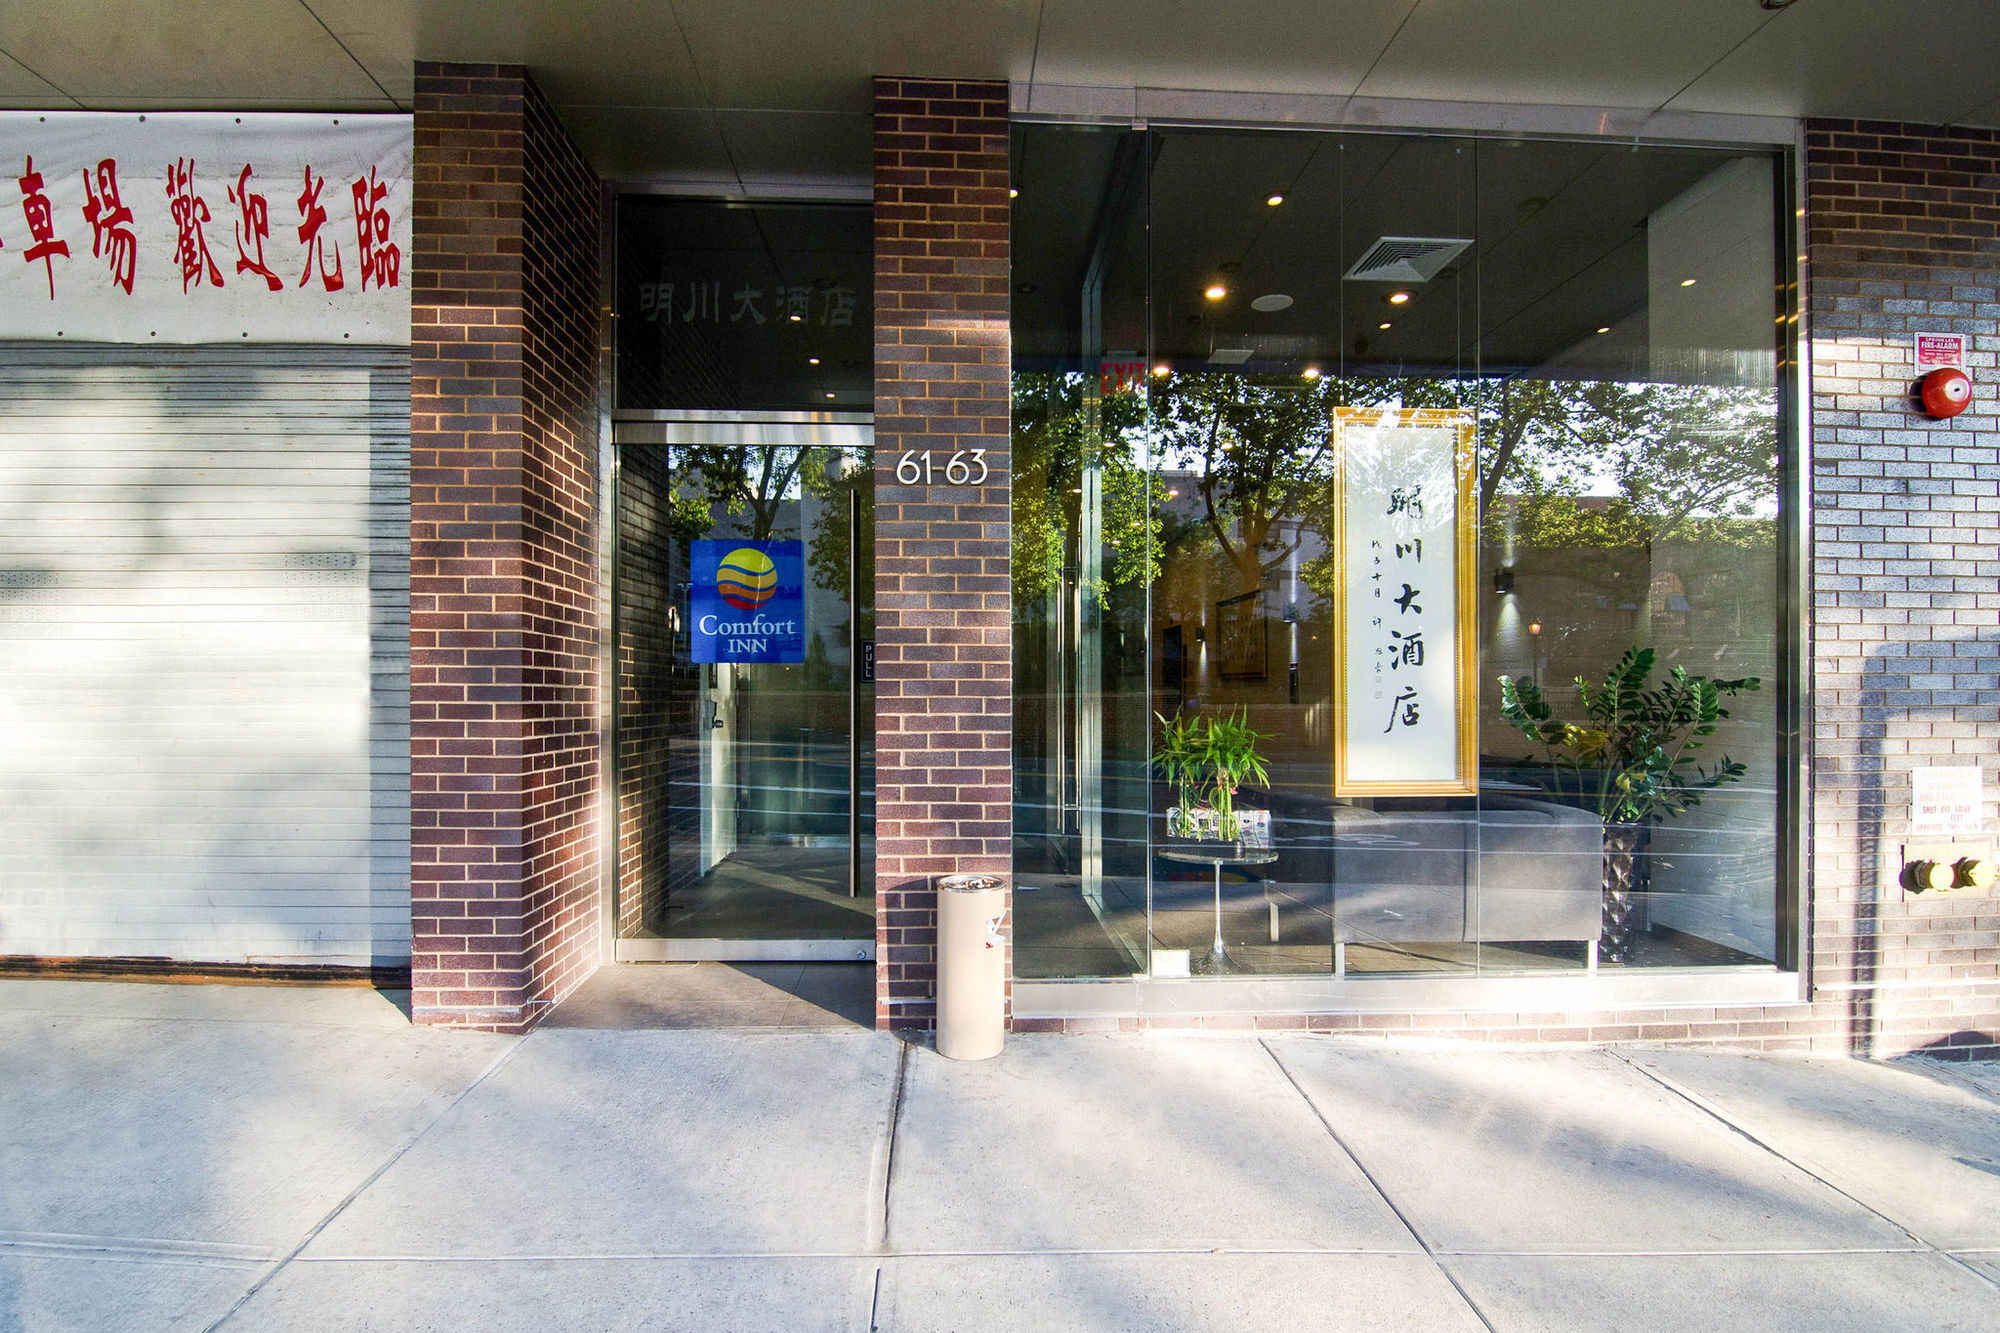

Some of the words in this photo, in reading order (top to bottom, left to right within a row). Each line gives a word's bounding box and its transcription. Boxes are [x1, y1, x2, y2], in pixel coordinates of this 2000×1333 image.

[0, 154, 401, 301] 車場歡迎光臨
[638, 280, 858, 327] 明川大酒店
[1101, 362, 1146, 394] EXIT
[896, 448, 988, 485] 61-63
[699, 614, 797, 636] Comfort
[728, 639, 767, 653] INN
